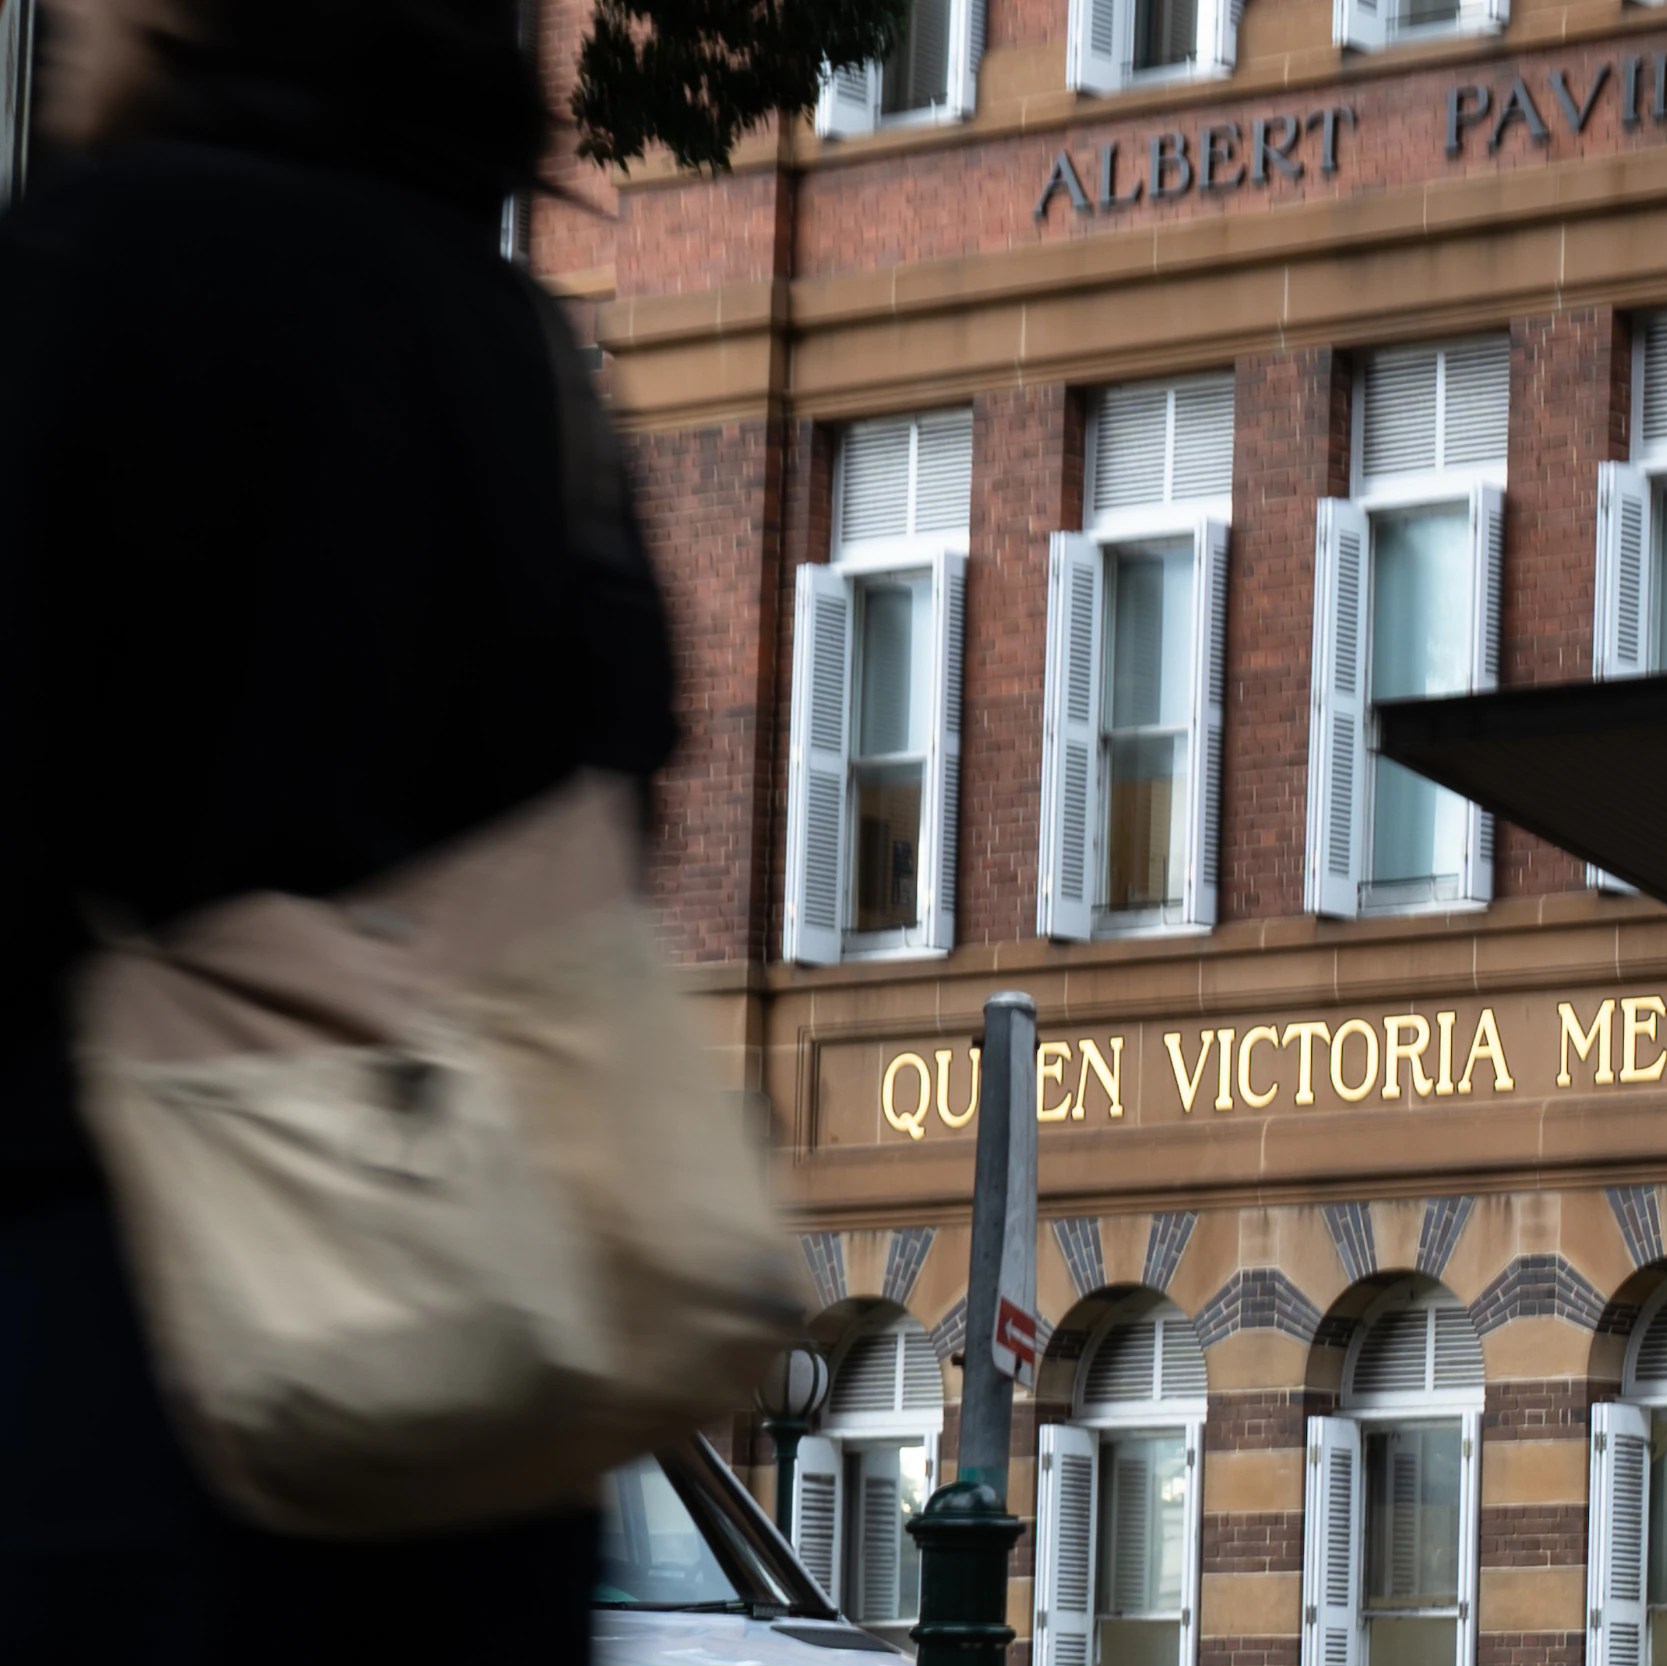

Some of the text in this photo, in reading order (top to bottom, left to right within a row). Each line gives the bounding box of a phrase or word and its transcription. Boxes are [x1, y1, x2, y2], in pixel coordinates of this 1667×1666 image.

[1034, 106, 1356, 221] ALBERT
[882, 1036, 1125, 1141] QUEN
[1164, 1008, 1514, 1112] VICTORIA
